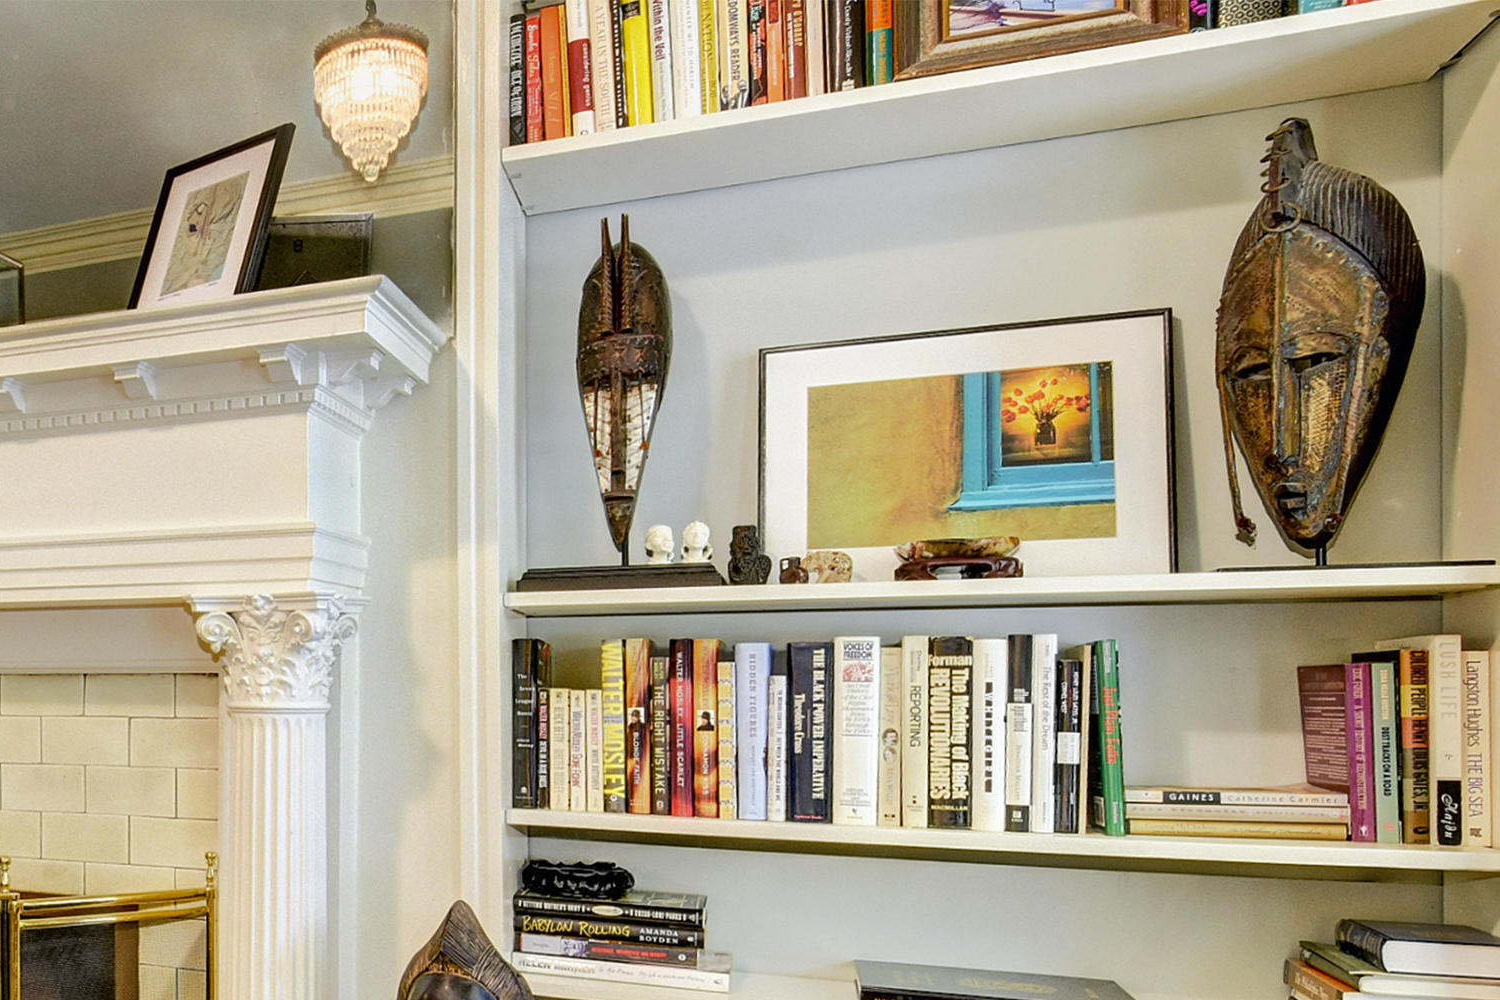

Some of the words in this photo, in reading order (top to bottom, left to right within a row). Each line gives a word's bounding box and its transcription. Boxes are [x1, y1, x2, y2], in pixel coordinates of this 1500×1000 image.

[595, 13, 606, 43] YEAR
[653, 26, 664, 41] the
[582, 43, 590, 82] considering
[654, 43, 666, 61] Veil
[731, 48, 740, 81] READER
[598, 61, 608, 80] THE
[599, 82, 610, 116] SOUTH
[676, 652, 684, 682] WALTER
[813, 648, 824, 668] THE
[928, 655, 972, 666] Forman
[1411, 650, 1428, 685] COLORED
[1439, 642, 1456, 680] LUSH
[601, 640, 624, 716] WALTER
[749, 653, 757, 692] HIDDEN
[813, 670, 824, 701] BLACK
[951, 668, 969, 693] The
[1043, 667, 1051, 681] The
[1463, 661, 1481, 706] Langston
[654, 685, 665, 706] THE
[1043, 682, 1051, 699] Rest
[1102, 686, 1117, 706] Just
[1411, 688, 1428, 717] PEOPLE
[1440, 687, 1457, 719] LIFE
[794, 693, 805, 731] Theodore
[910, 685, 921, 748] REPORTING
[1042, 701, 1051, 709] of
[1042, 711, 1051, 723] the
[654, 710, 665, 743] RIGHT
[812, 703, 824, 739] POWER
[950, 695, 969, 743] Making
[1105, 709, 1118, 735] Plain
[1412, 719, 1428, 745] HENRY
[1463, 709, 1482, 748] Hughes
[676, 723, 684, 748] LITTLE
[794, 732, 805, 754] Cross
[930, 668, 950, 800] REVOLUTIONARIES
[1042, 724, 1050, 751] Dream
[1381, 727, 1390, 741] DUST
[603, 722, 625, 799] MOSLEY
[952, 747, 969, 759] of
[1106, 737, 1120, 765] Folks
[1382, 742, 1390, 763] TRACKS
[1412, 748, 1428, 770] LOUIS
[654, 747, 665, 795] MISTAKE
[812, 740, 824, 800] IMPERATIVE
[1383, 764, 1390, 772] ON
[1467, 753, 1482, 776] THE
[951, 762, 969, 800] Black
[1383, 780, 1391, 796] ROAD
[1468, 777, 1482, 794] BIG
[1169, 793, 1215, 802] GAINES
[1227, 795, 1284, 803] Catherine
[1290, 795, 1339, 804] Carmier
[1469, 796, 1483, 818] SEA
[523, 916, 575, 933] BABYLON
[579, 921, 631, 937] ROLLING
[639, 935, 679, 944] BOYDEN
[640, 928, 679, 937] AMANDA
